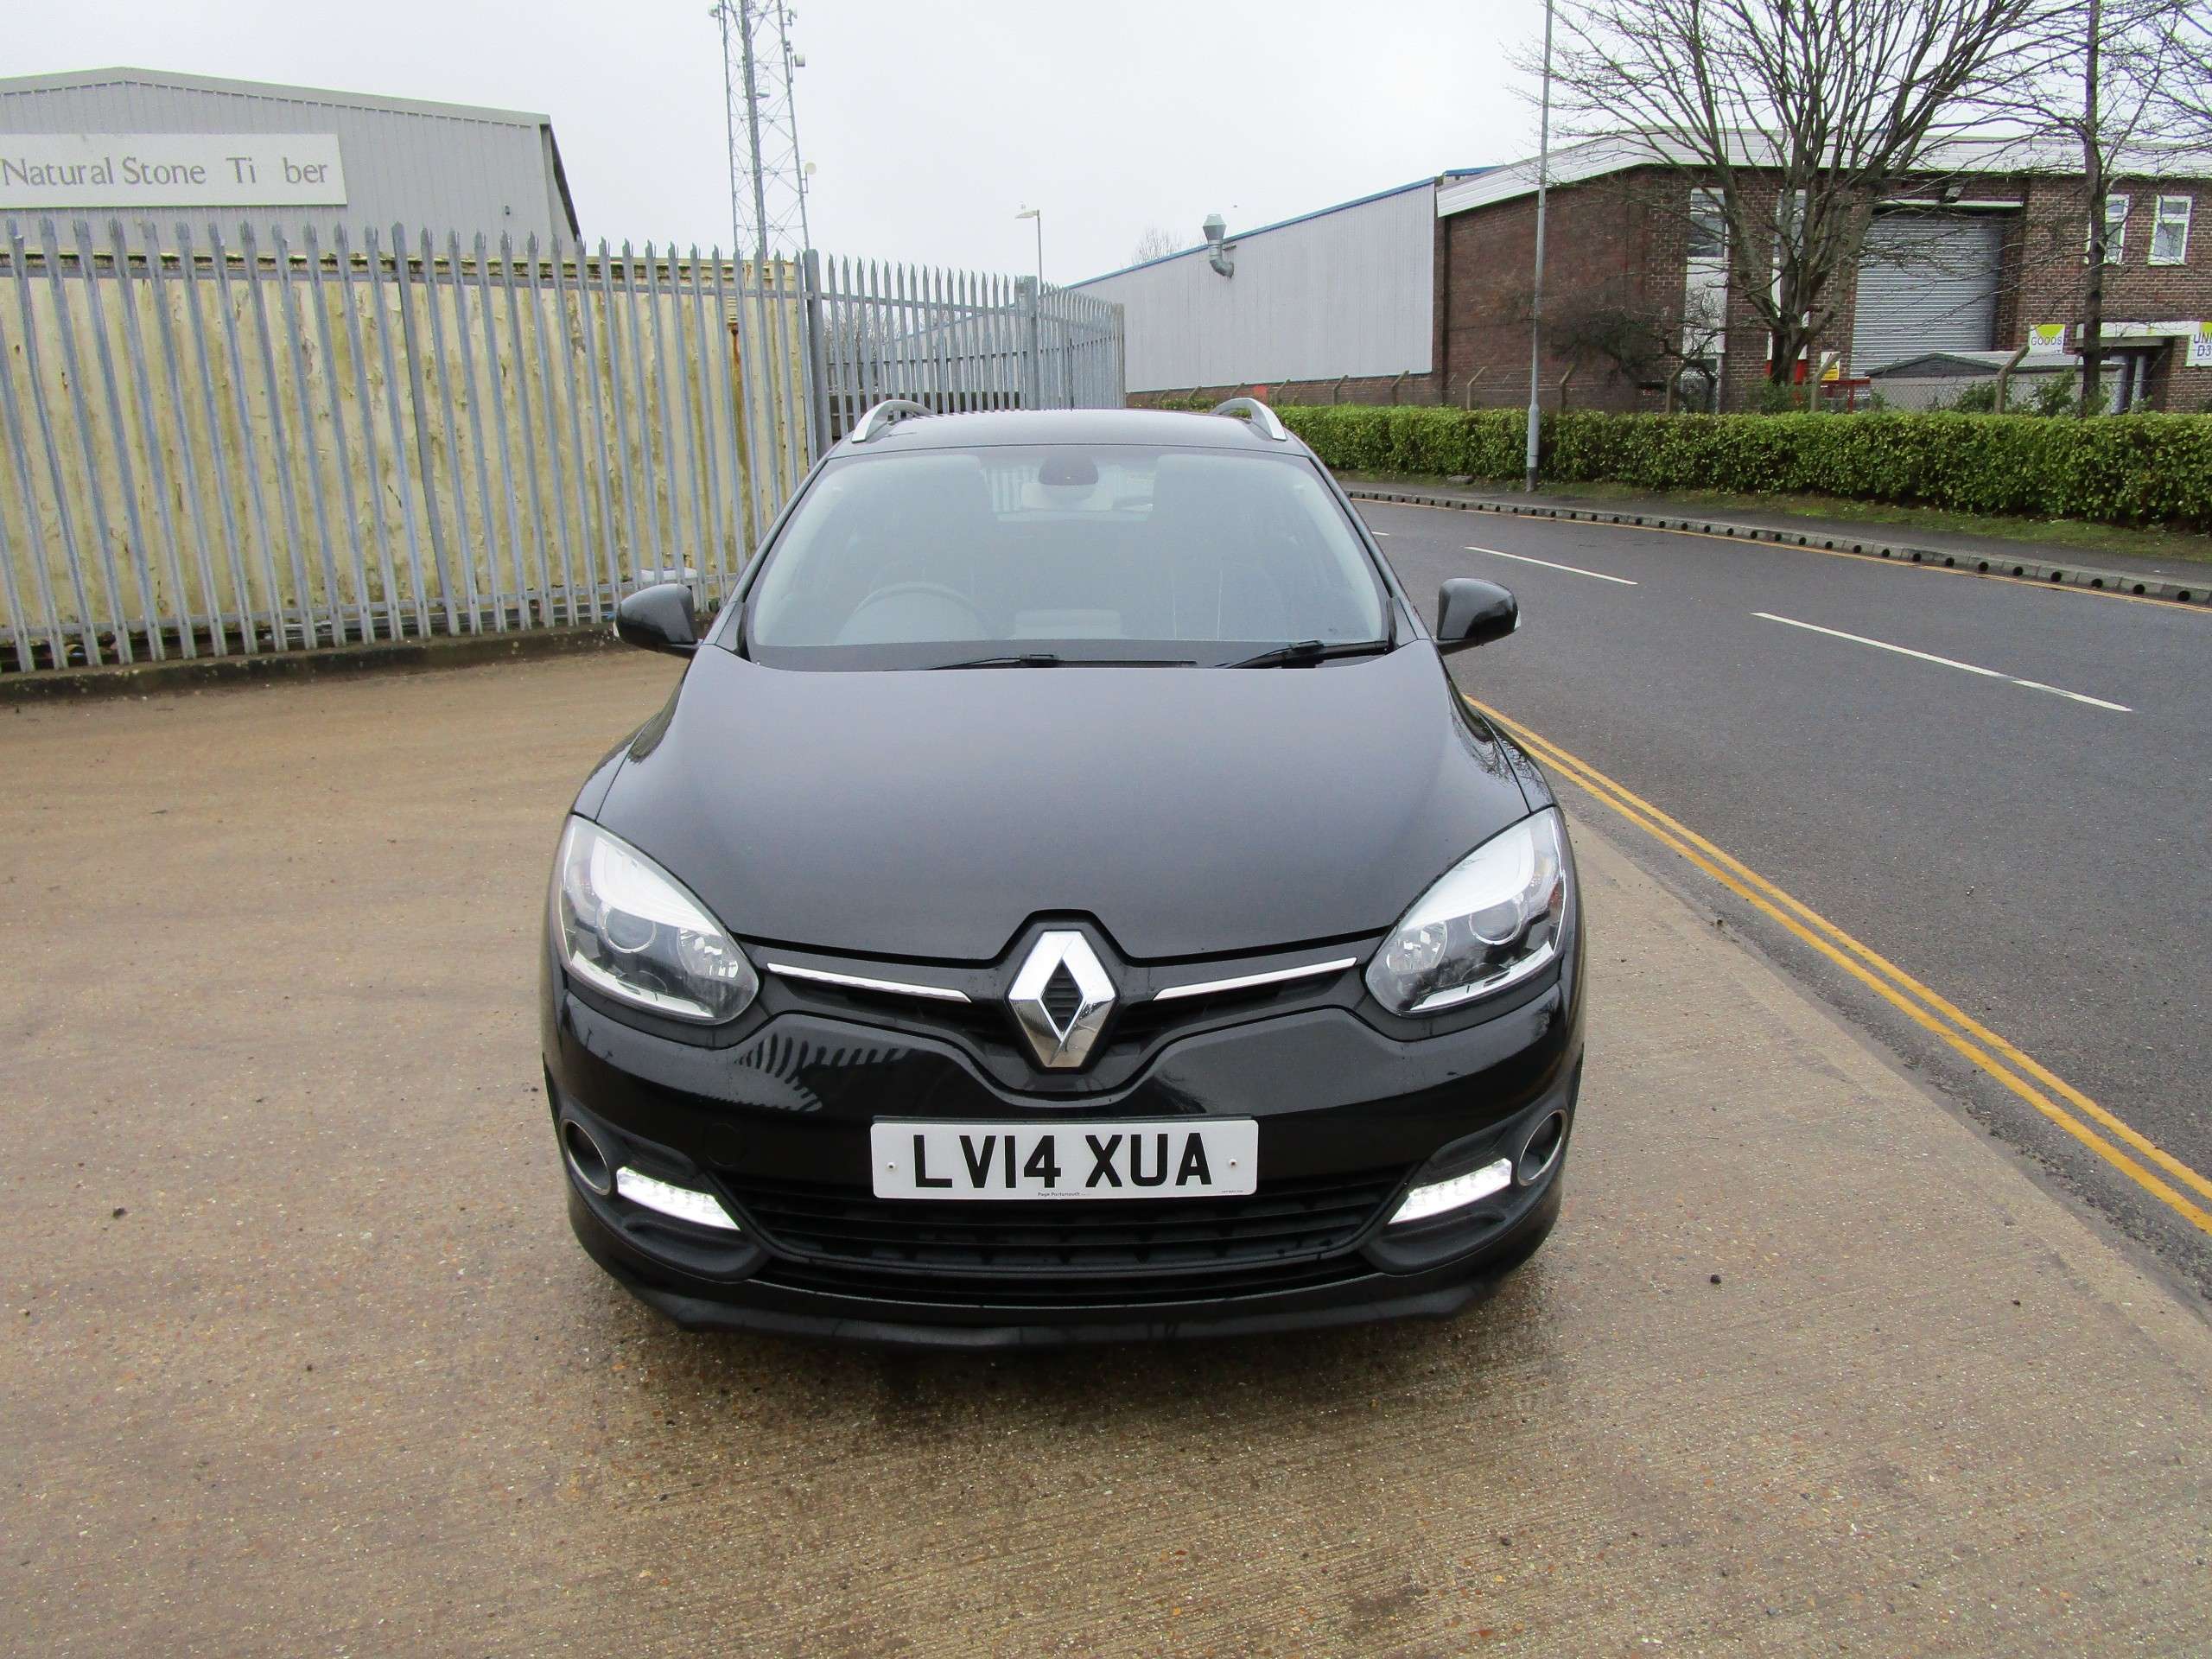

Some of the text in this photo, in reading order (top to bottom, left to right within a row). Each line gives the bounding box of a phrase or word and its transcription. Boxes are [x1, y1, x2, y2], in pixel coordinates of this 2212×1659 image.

[1, 156, 115, 187] Natural
[122, 156, 207, 186] Stone
[2031, 336, 2063, 346] GOODS
[912, 1132, 1212, 1189] LV14 XUA
